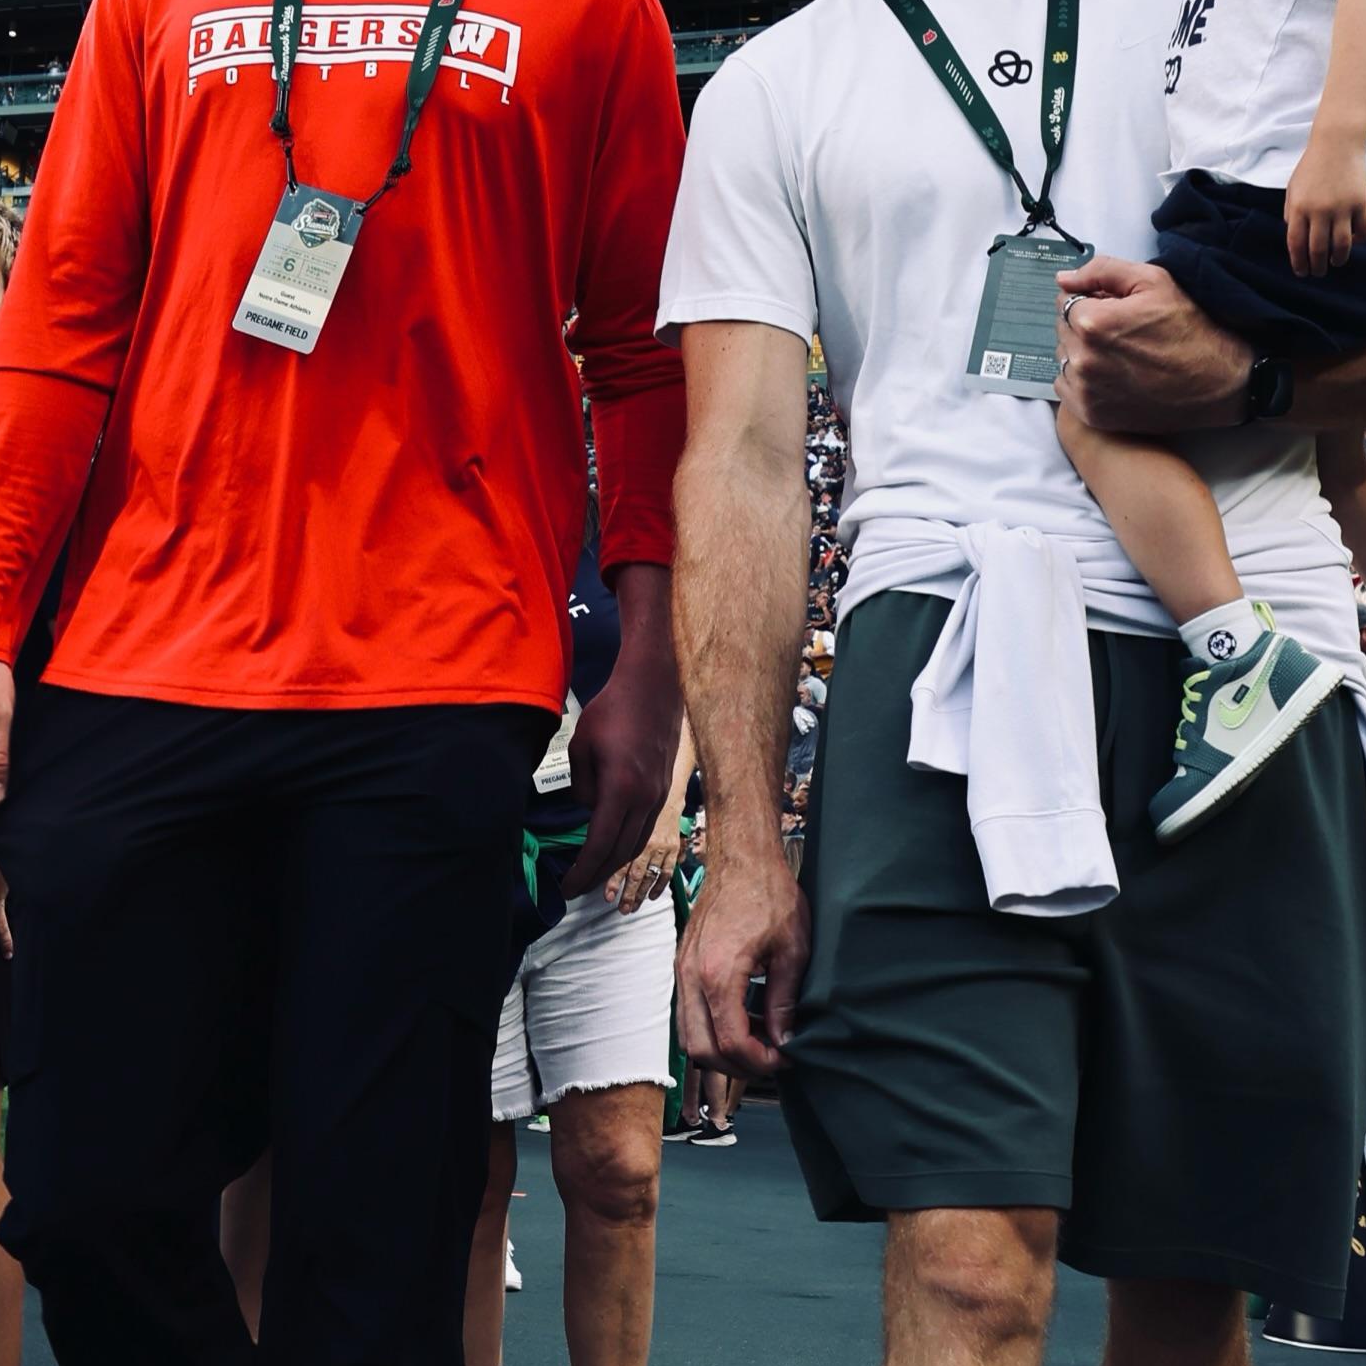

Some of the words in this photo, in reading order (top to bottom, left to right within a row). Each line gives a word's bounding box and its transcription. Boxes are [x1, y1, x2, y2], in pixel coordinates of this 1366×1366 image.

[448, 23, 497, 58] W
[188, 61, 511, 106] FOTBLL
[283, 258, 296, 272] 6
[245, 310, 285, 332] PREGAME
[284, 324, 309, 340] FIELD
